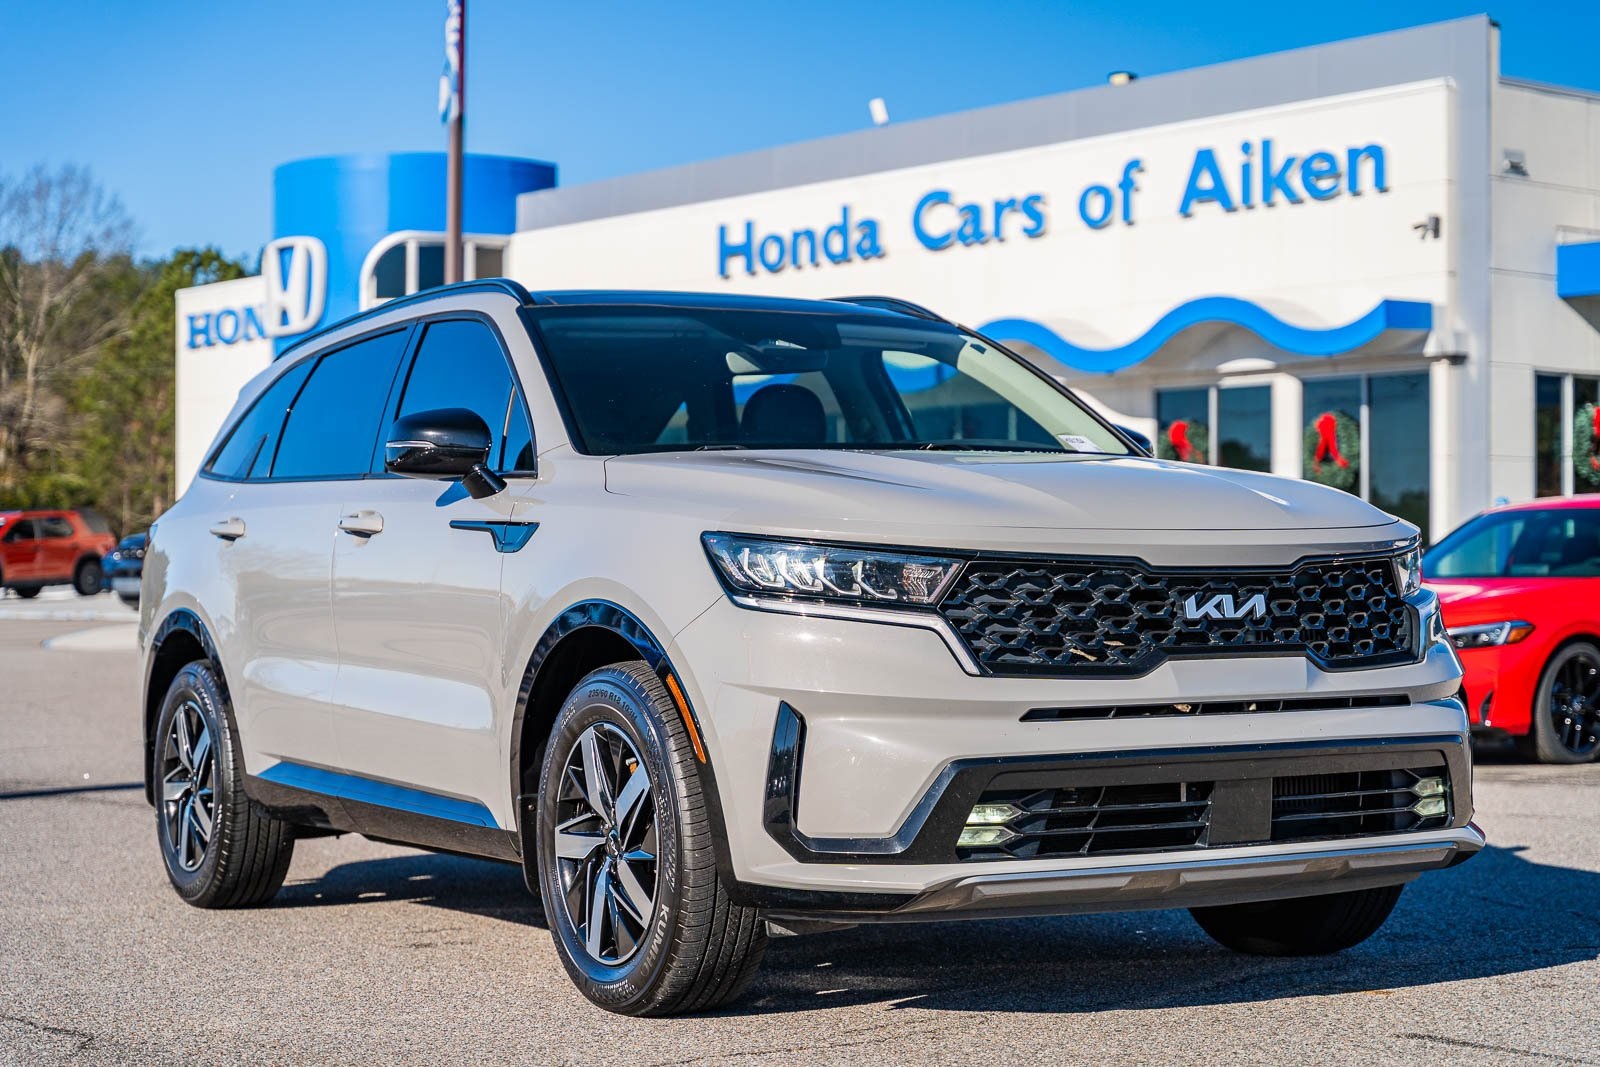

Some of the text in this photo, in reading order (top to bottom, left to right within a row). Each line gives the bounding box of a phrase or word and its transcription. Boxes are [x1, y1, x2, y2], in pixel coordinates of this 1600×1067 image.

[718, 138, 1388, 279] Honda Cars of Aiken
[1184, 593, 1267, 619] KIA
[640, 903, 670, 977] KUMHO
